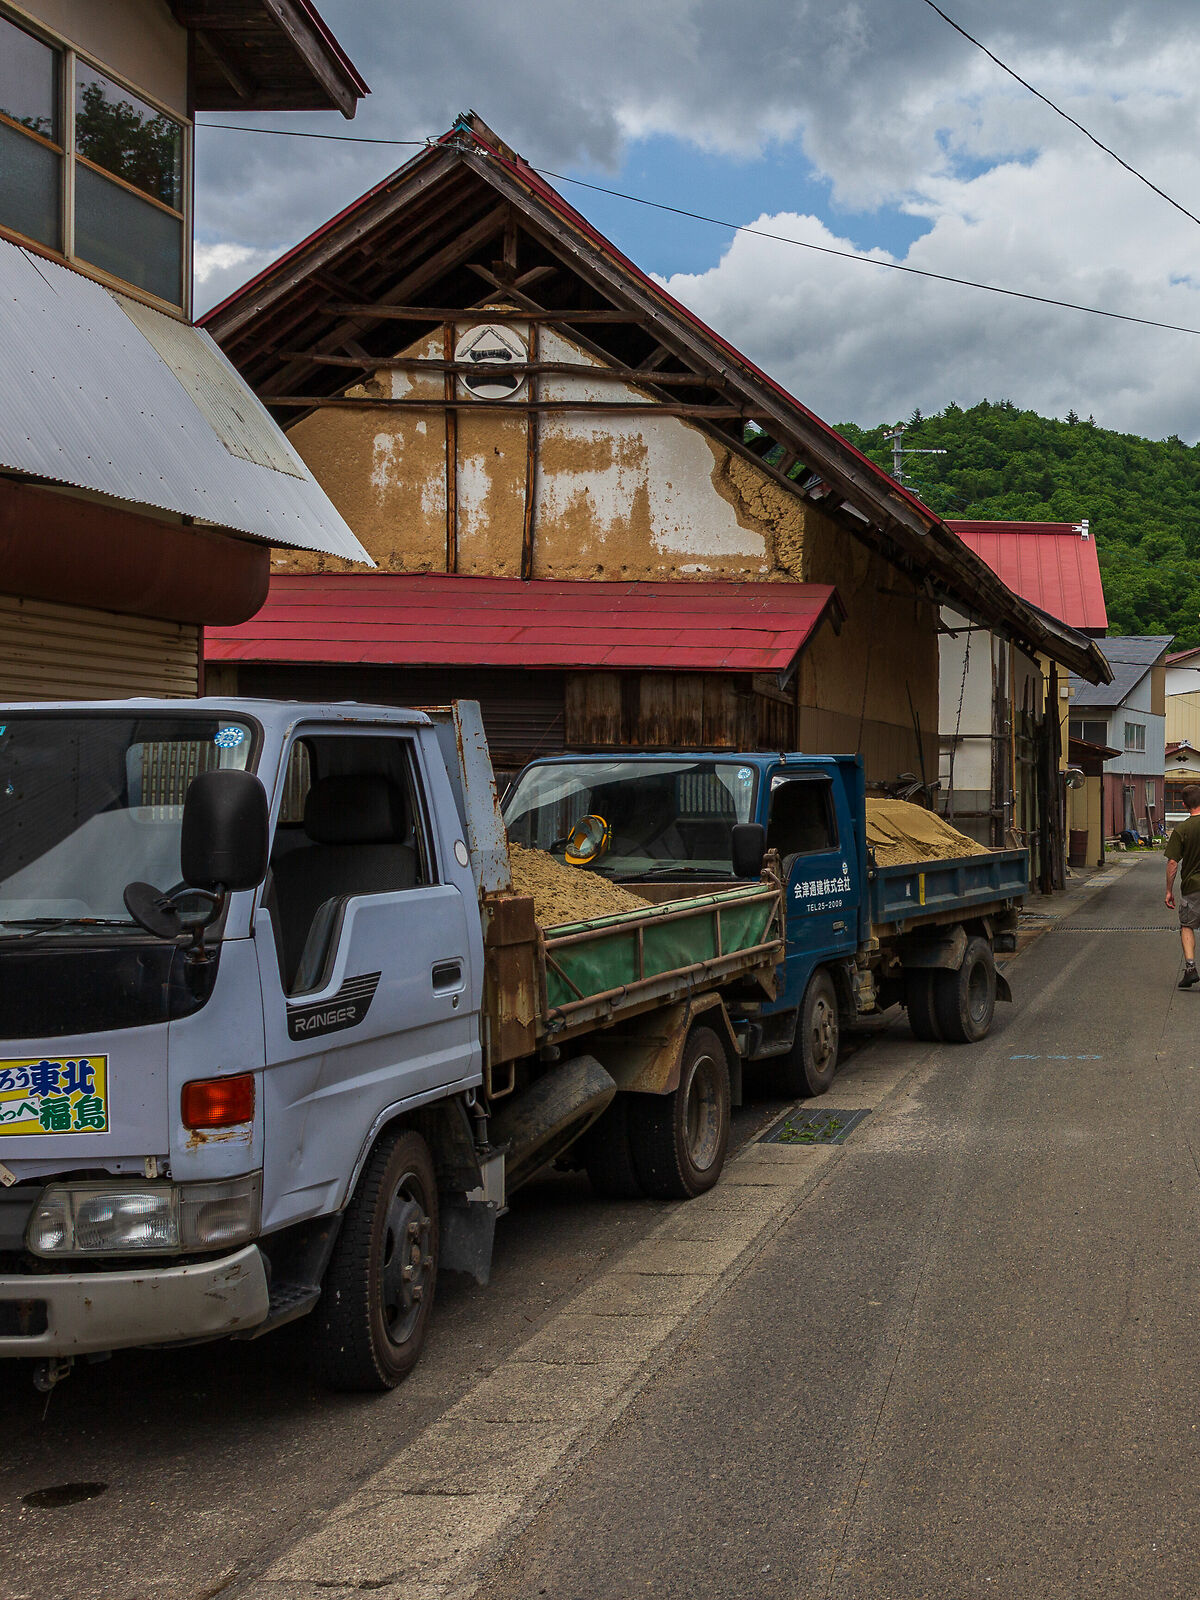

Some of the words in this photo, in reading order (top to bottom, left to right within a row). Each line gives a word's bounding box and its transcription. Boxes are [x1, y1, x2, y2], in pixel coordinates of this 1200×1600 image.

[807, 900, 842, 912] TEL25-2009
[295, 1007, 356, 1032] RANGER
[0, 1095, 105, 1130] っぺ福島
